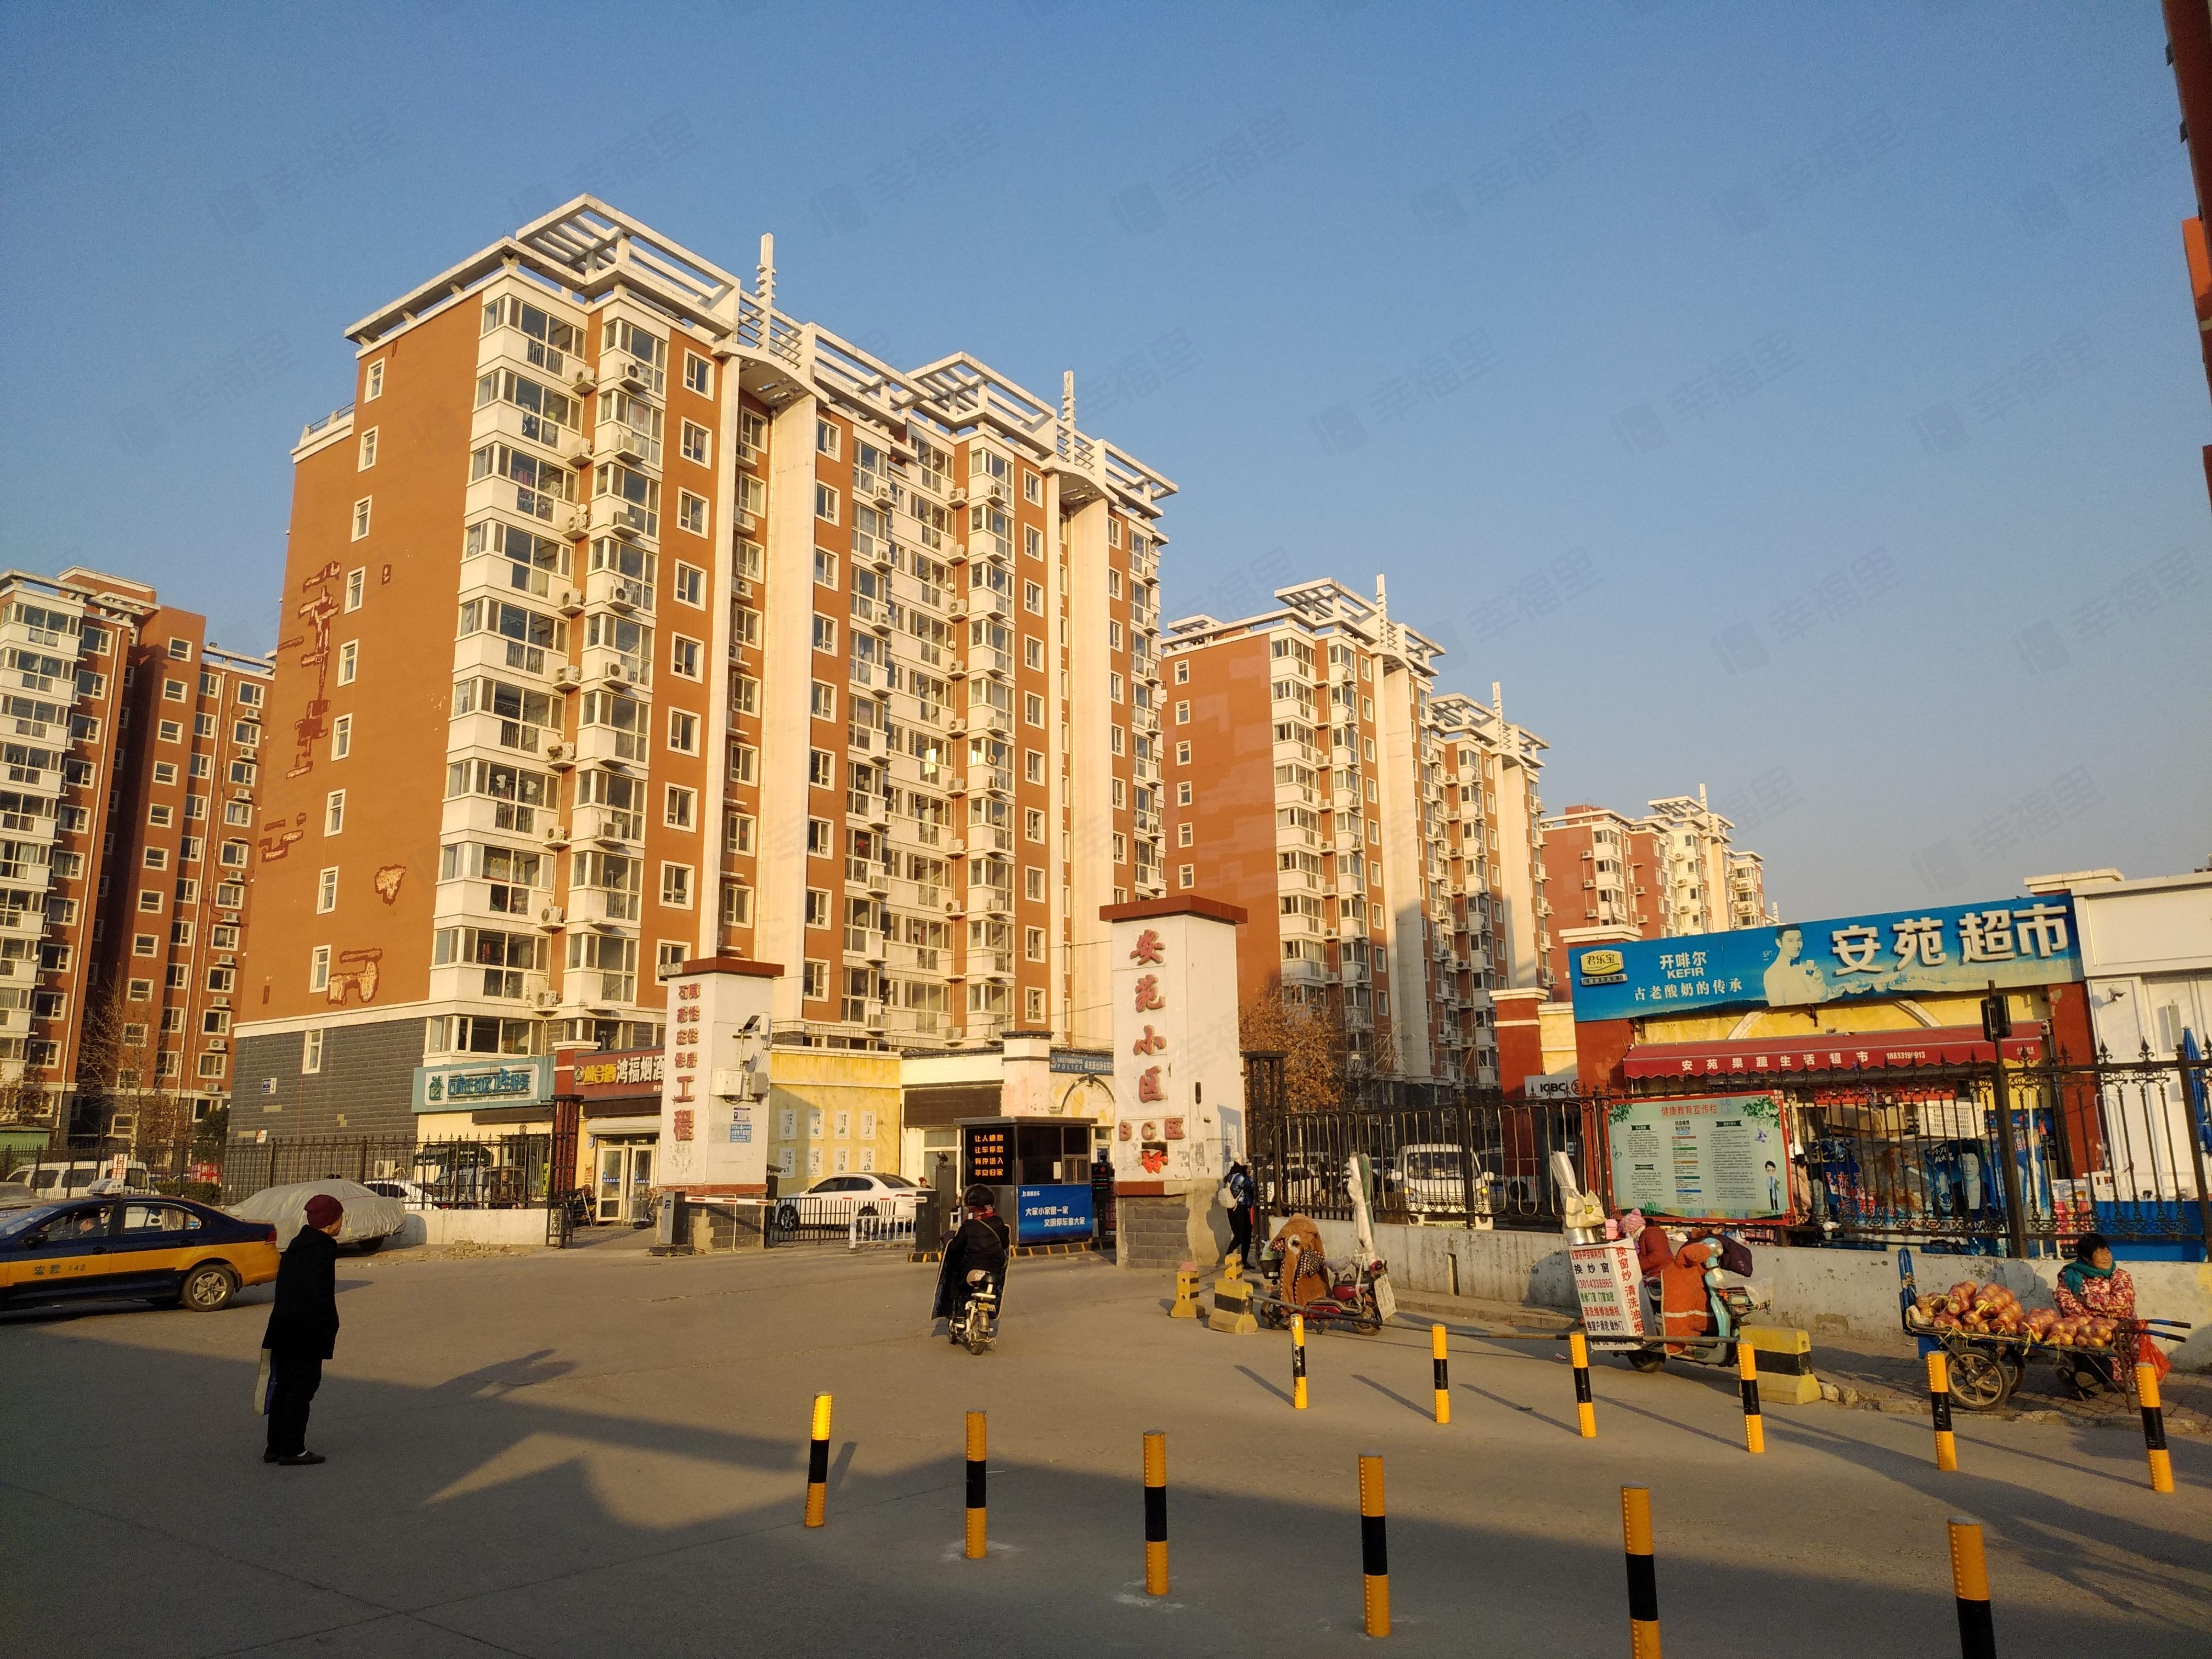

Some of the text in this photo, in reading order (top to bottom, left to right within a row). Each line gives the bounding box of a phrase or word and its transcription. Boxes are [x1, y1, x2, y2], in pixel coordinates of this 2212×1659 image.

[1832, 903, 2068, 977] 安苑超市
[1586, 953, 1616, 966] 君乐宝
[1659, 951, 1707, 970] 开啡尔
[1667, 967, 1705, 979] KEFIR
[1634, 977, 1743, 1001] 古老酸奶的传承
[1130, 929, 1166, 1103] 安苑小区
[1681, 1051, 1869, 1071] 安苑果蔬生活超市
[271, 1080, 275, 1091] 3
[1540, 1082, 1566, 1092] ICBC
[674, 1075, 696, 1141] 工程
[1661, 1103, 1718, 1116] 健康教育宣传栏
[1025, 1205, 1069, 1216] 大家小家是一家
[1044, 1216, 1086, 1227] 文明停车靠大家
[69, 1263, 86, 1271] 142
[1573, 1262, 1610, 1274] 换纱窗
[1615, 1246, 1632, 1282] 换窗纱
[1576, 1278, 1613, 1289] 13014338965
[1583, 1306, 1621, 1318] 清洗维修油烟机
